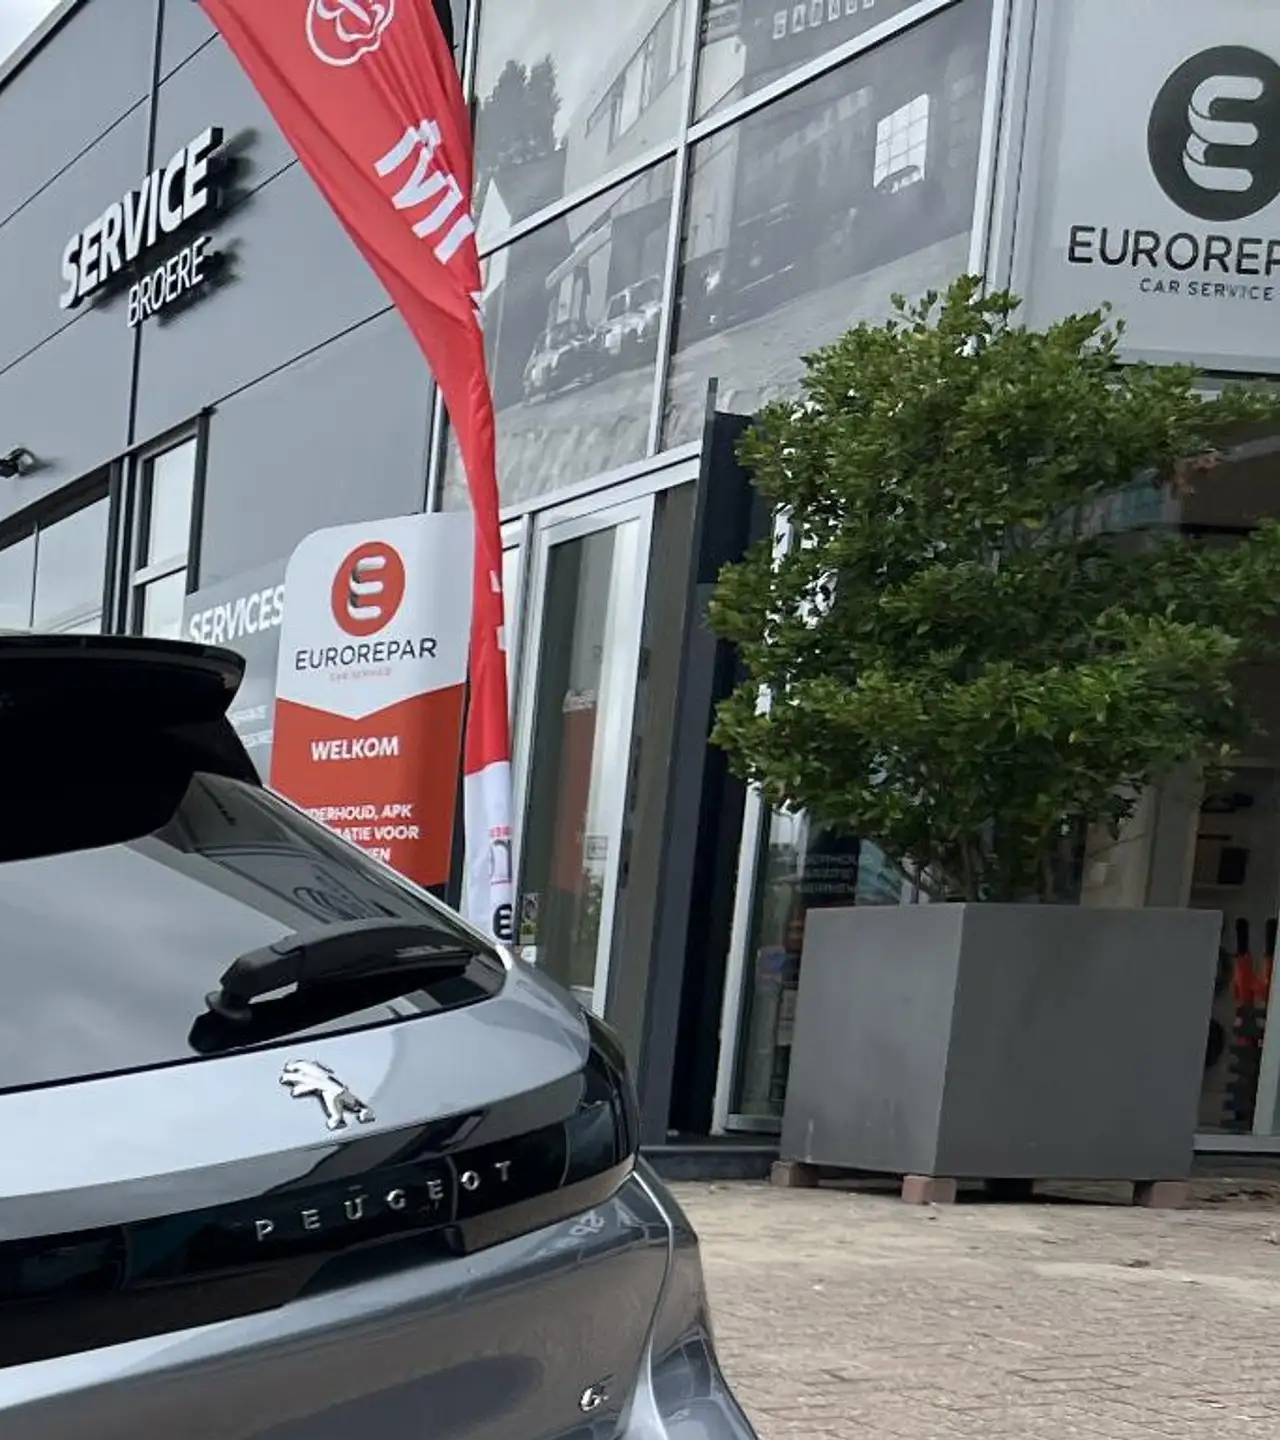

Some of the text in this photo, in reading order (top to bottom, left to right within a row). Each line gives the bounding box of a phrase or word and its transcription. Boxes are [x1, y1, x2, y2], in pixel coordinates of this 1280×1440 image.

[60, 126, 218, 310] SERVICE
[126, 236, 208, 328] BROERE
[1139, 277, 1274, 302] CAR SERVICE
[189, 584, 286, 645] SERVICES
[294, 637, 438, 672] EUROREPAR
[310, 736, 401, 762] WELKOM
[381, 803, 414, 818] APK
[374, 825, 420, 840] VOOR
[254, 1159, 513, 1243] PEUGEOT
